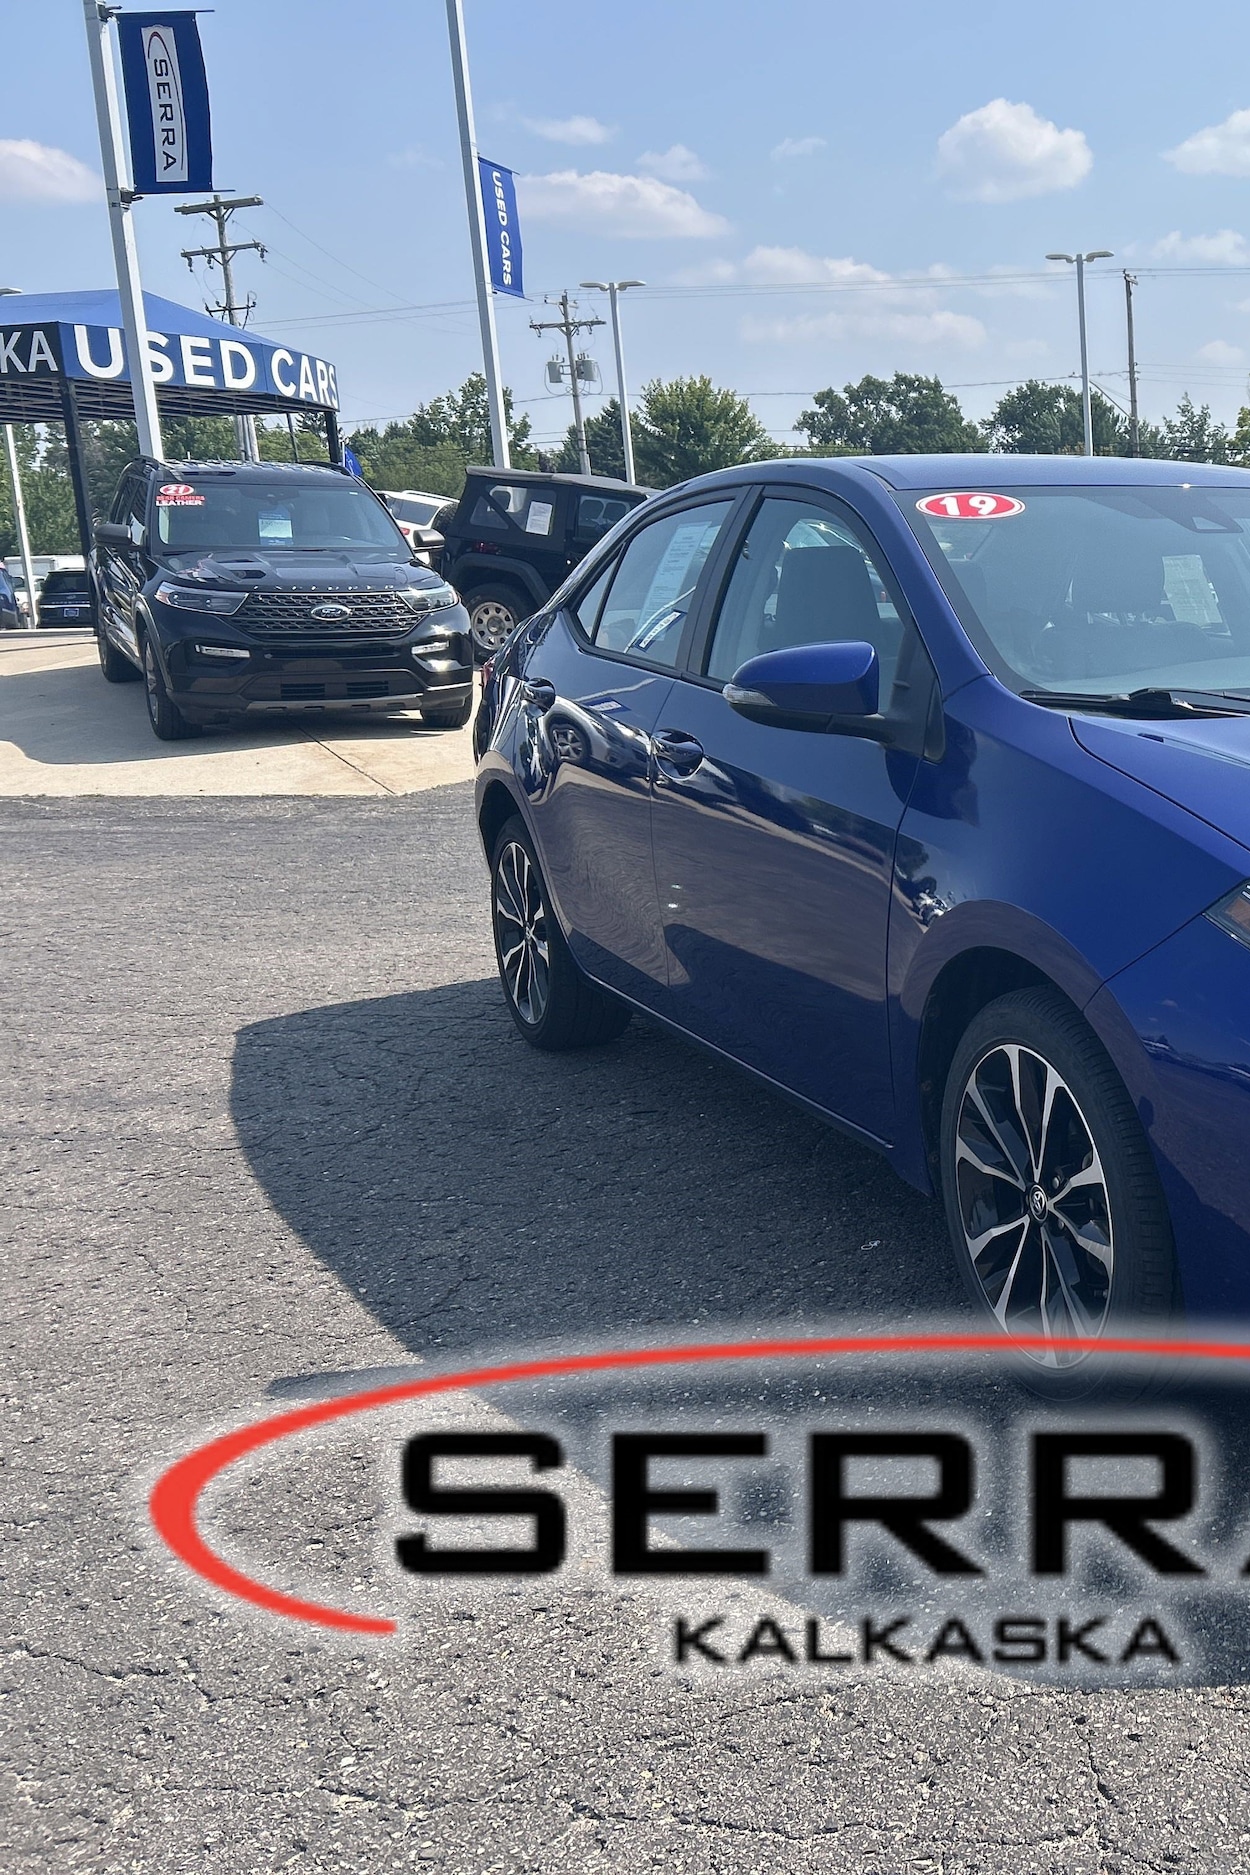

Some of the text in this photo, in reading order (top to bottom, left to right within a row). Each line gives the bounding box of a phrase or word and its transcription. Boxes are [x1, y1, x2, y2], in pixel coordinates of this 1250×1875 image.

[153, 58, 177, 171] SERRA
[492, 170, 512, 286] USED CARS
[73, 324, 340, 411] USED CARS
[939, 495, 998, 517] 19
